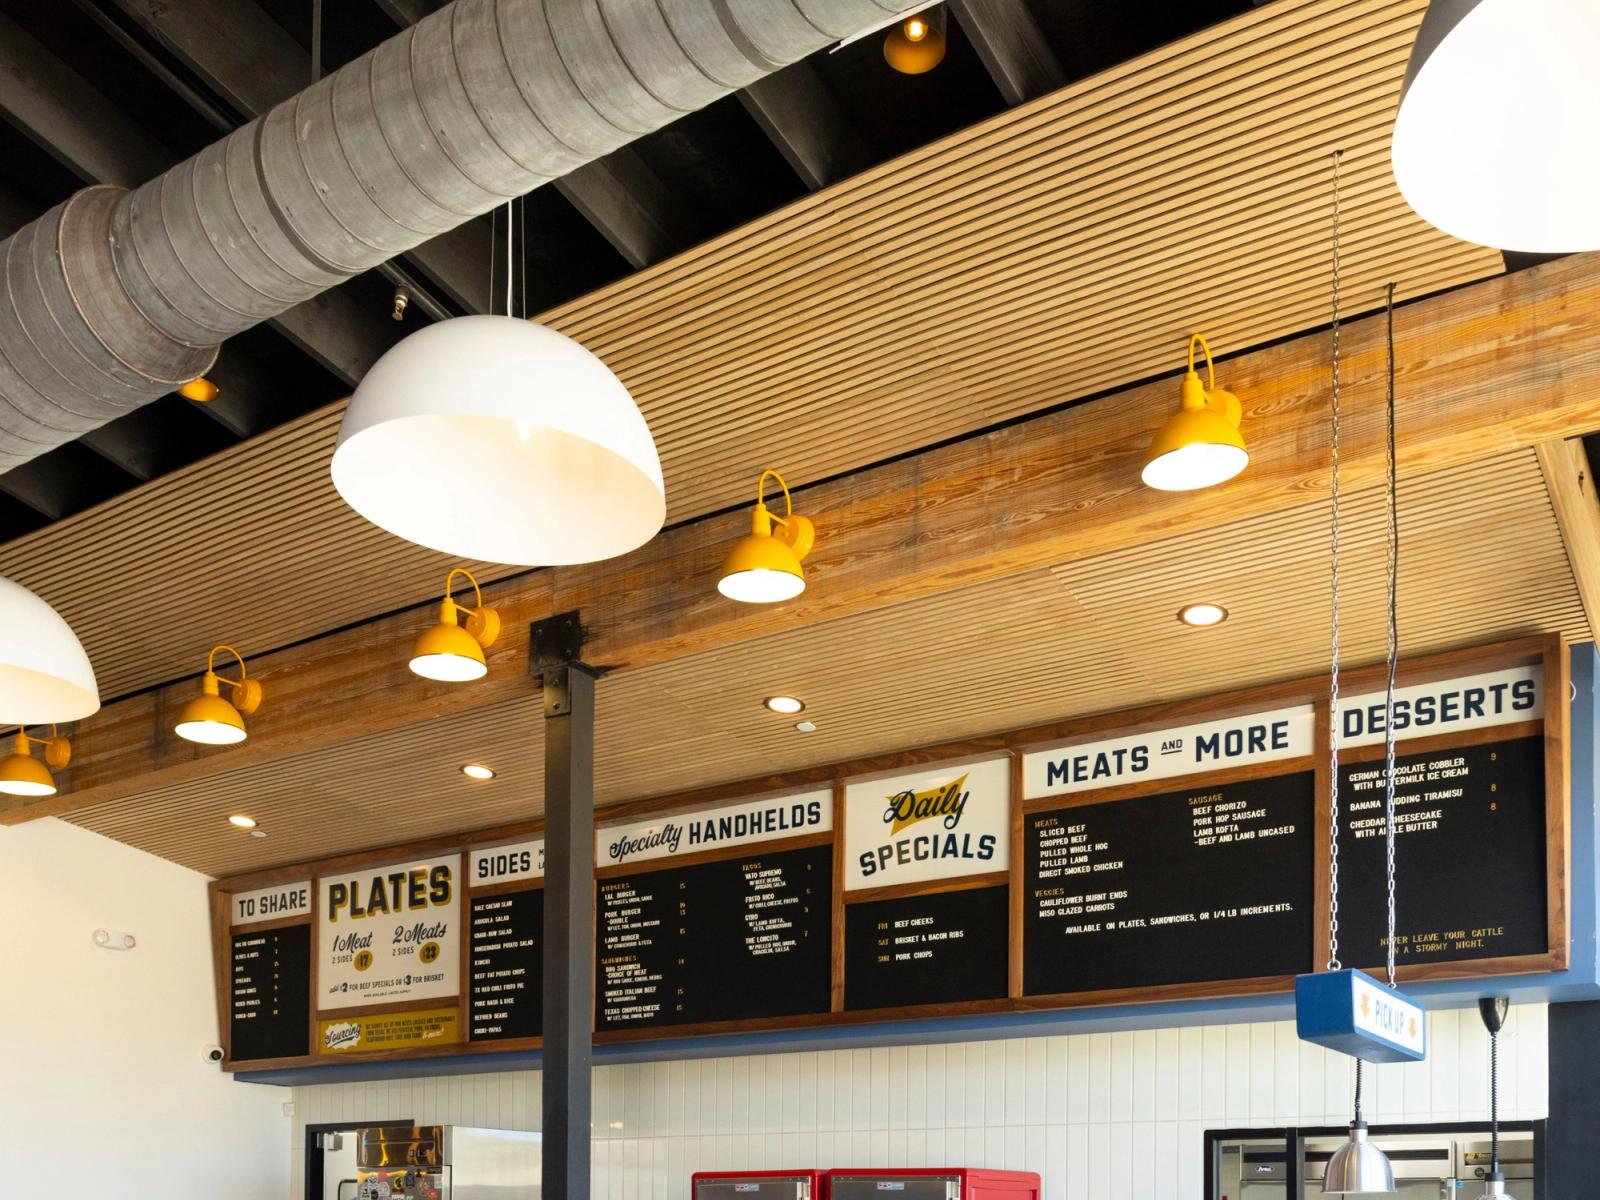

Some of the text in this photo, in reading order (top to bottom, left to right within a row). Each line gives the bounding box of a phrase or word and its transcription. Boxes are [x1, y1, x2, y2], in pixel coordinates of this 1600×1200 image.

[1343, 679, 1535, 738] DESSERTS
[1047, 720, 1289, 786] MEATS AND MORE
[1349, 770, 1379, 782] GERMAN
[1429, 758, 1465, 770] COBBLER
[1354, 767, 1469, 791] WITH BUERMILK ICE CREAM
[883, 784, 970, 830] Daily
[1188, 793, 1224, 806] SAUSAGE
[1193, 801, 1247, 815] BEEF CHORIZO
[1350, 788, 1463, 811] BANANA UDDING TIRAMISU
[1034, 818, 1058, 828] MEATS
[1193, 817, 1212, 826] PORK
[1232, 809, 1266, 821] SAUSAGE
[1350, 810, 1442, 829] CHEDDAR HEESECAKE
[609, 801, 821, 862] Specialty HANDHELDS
[1040, 824, 1086, 838] SLICED BEEF
[1193, 824, 1239, 837] LAMB KOFTA
[1219, 834, 1233, 843] AND
[1235, 831, 1255, 841] LAMB
[1258, 825, 1295, 837] UNCASED
[1355, 829, 1375, 839] WITH
[1406, 820, 1437, 832] BUTTER
[1039, 834, 1088, 848] CHOPPED BEEF
[1040, 842, 1109, 858] PULLED WHOLE HOG
[859, 833, 997, 877] SPECIALS
[1040, 855, 1088, 868] PULLED LAMB
[478, 850, 531, 879] SIDES
[1039, 861, 1123, 879] DIRECT SMOKED CHICKEN
[329, 864, 452, 923] PLATES
[1040, 891, 1128, 908] CAULIFLOWER BURNT ENDS
[238, 889, 307, 918] TO SHARE
[1039, 903, 1115, 918] MISO GLAZED CARROTS
[894, 920, 909, 929] BEEF
[910, 917, 934, 927] CHEEKS
[1065, 923, 1101, 935] AVAILABLE
[1106, 922, 1115, 930] ON
[1119, 919, 1147, 930] PLATES,
[1200, 912, 1210, 920] OR
[1213, 909, 1226, 919] 1/4
[1227, 909, 1237, 917] LB
[1240, 903, 1293, 916] INCREMENTS.
[332, 931, 373, 954] 1 Meat
[392, 922, 448, 945] 2 Meats
[895, 935, 919, 945] BRISKET
[921, 934, 927, 942] &
[928, 932, 948, 941] BACON
[949, 930, 964, 939] RIBS
[1412, 933, 1440, 943] LEAVE
[1444, 931, 1466, 940] YOUR
[1471, 926, 1504, 938] CATTLE
[397, 946, 415, 956] SIDES
[895, 950, 933, 961] PORK CHOPS
[1415, 942, 1448, 952] STORMY
[337, 954, 353, 964] SIDES
[349, 982, 359, 992] FOR
[359, 980, 372, 991] BEEF
[372, 977, 395, 990] SPECIALS
[412, 975, 422, 984] FOR
[423, 973, 445, 983] BRISKET
[1375, 999, 1404, 1036] PICK UP
